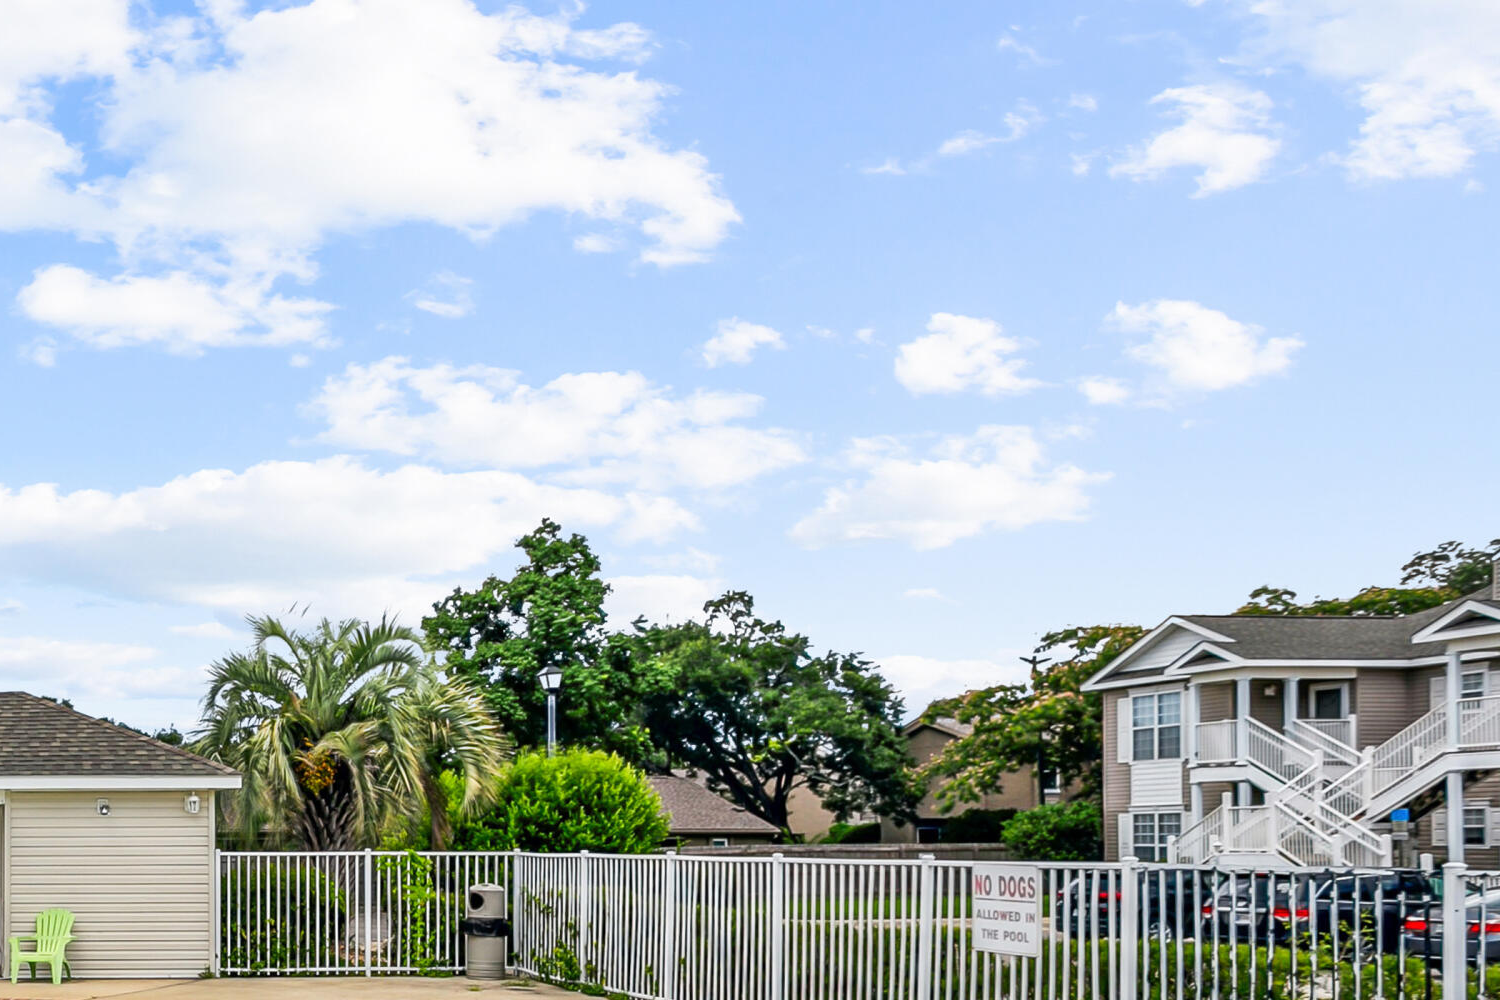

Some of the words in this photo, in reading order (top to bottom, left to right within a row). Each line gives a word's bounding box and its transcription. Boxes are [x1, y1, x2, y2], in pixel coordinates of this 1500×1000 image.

[974, 874, 992, 896] NO
[998, 875, 1036, 899] DOGS
[976, 908, 1021, 923] ALLOWED
[1025, 912, 1036, 924] IN
[981, 928, 999, 940] THE
[1003, 930, 1029, 943] POOL
